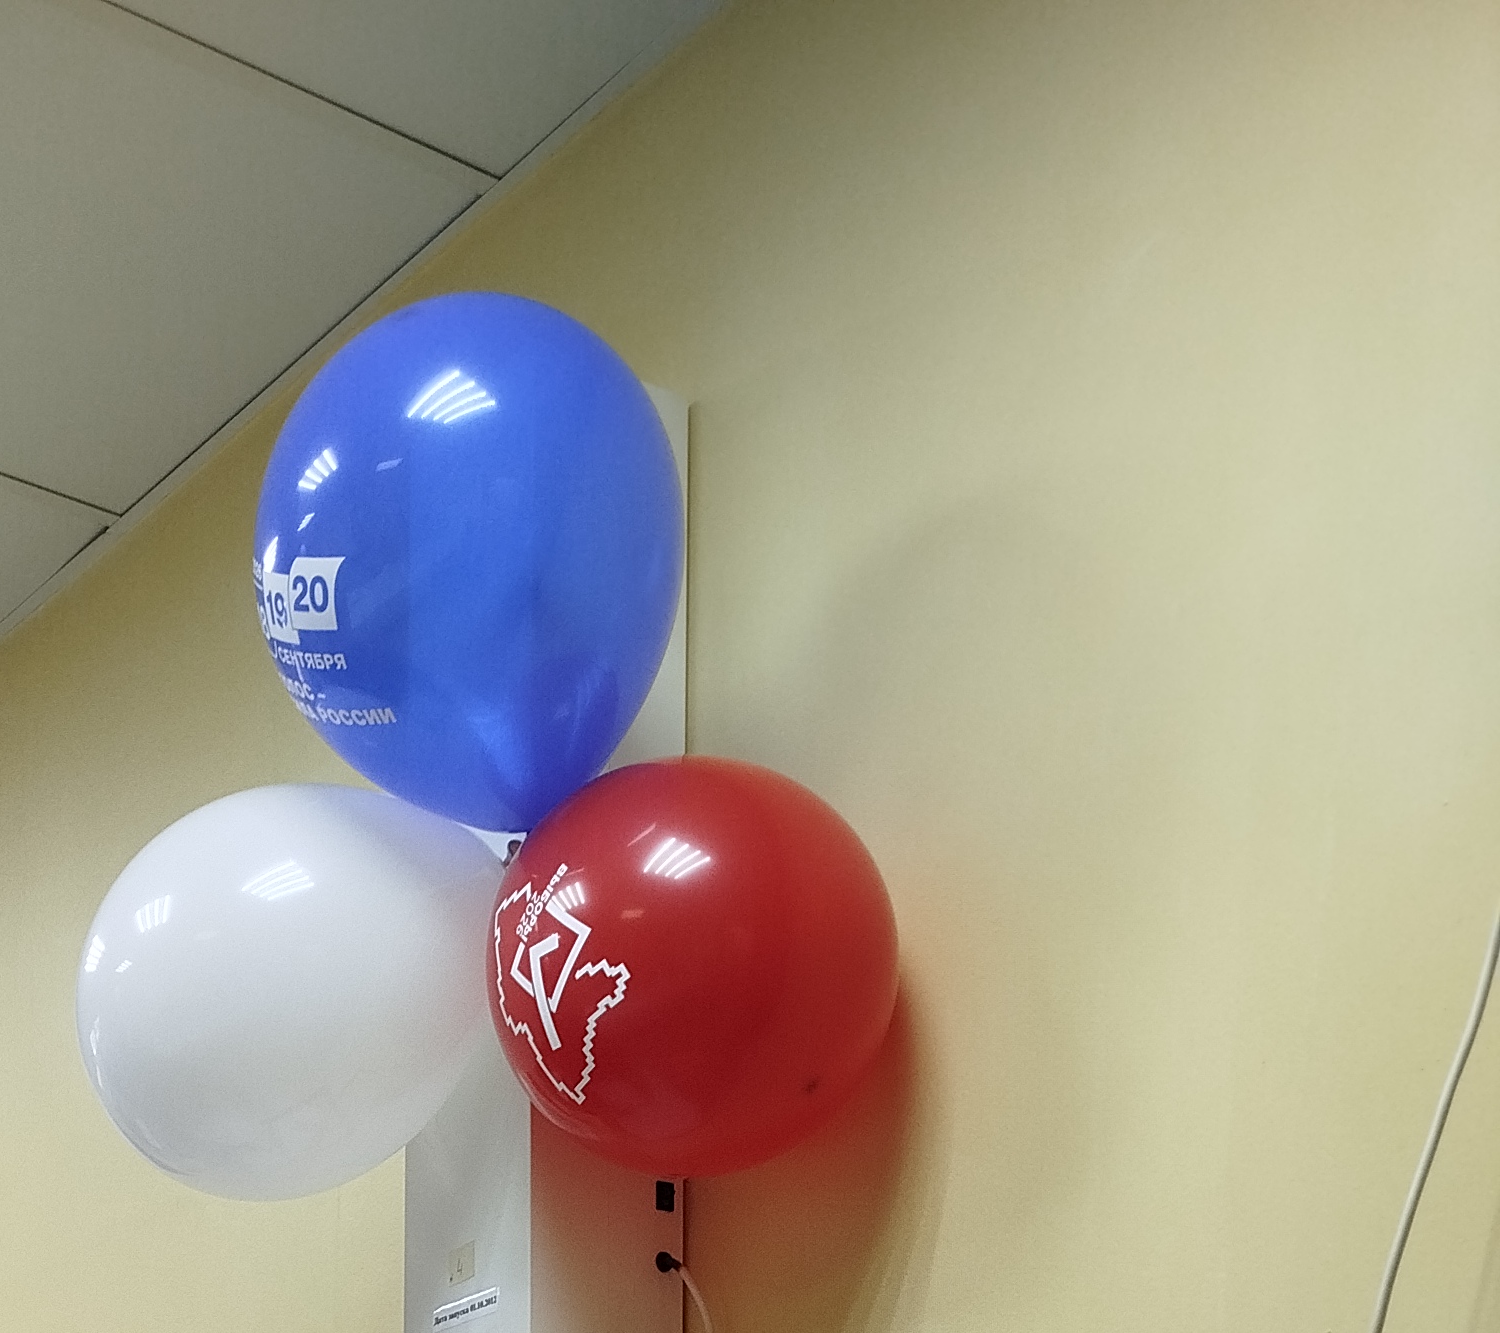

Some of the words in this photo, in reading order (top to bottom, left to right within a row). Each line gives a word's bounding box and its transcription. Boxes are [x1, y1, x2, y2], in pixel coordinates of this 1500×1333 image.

[266, 590, 288, 628] 19
[292, 575, 329, 613] 20
[277, 645, 348, 670] СЕНТЯБРЯ
[317, 704, 398, 726] РОССИИ
[515, 890, 541, 936] 2026
[521, 863, 568, 942] ВЫБОРЫ
